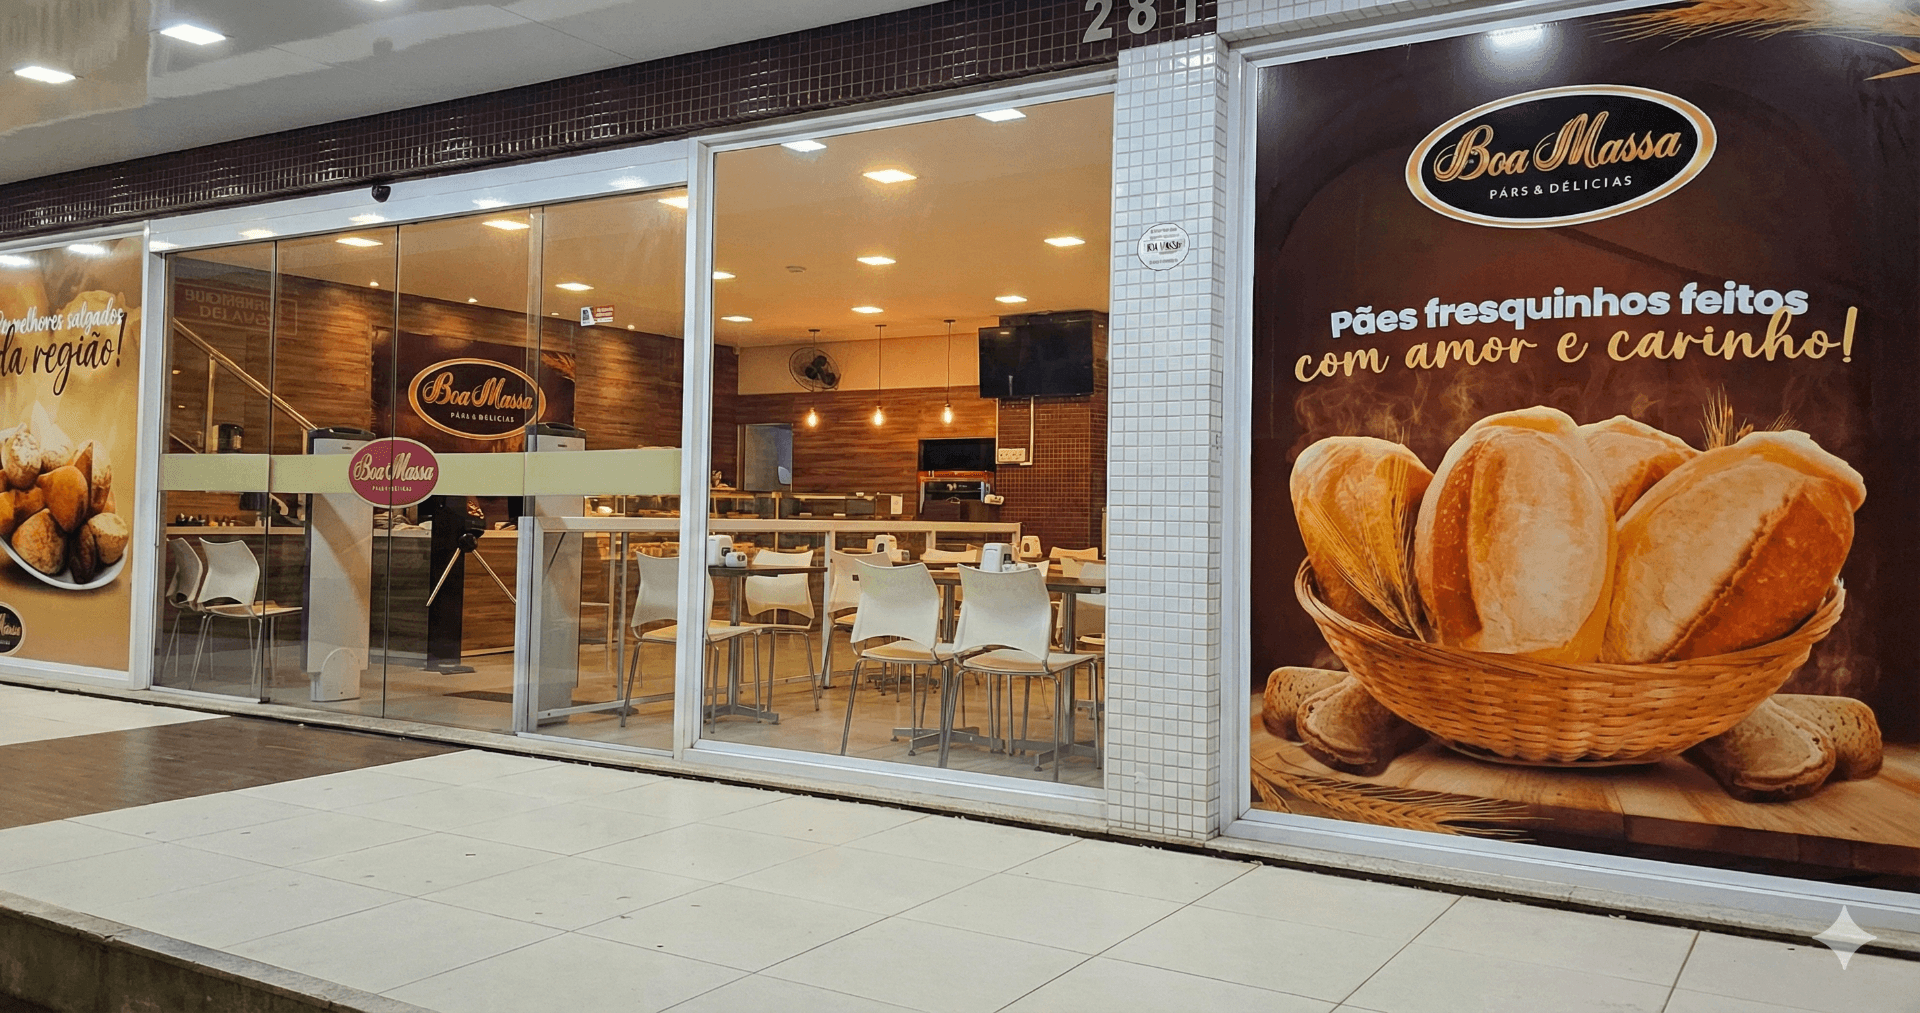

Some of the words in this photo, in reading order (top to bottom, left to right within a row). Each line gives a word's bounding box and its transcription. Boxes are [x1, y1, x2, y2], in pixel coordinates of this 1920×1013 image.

[1433, 124, 1530, 182] Boa
[1533, 110, 1682, 172] Massa
[1489, 186, 1529, 200] PÁRS
[1533, 184, 1543, 195] &
[1549, 175, 1632, 194] DÉLICIAS
[67, 296, 124, 336] salgados
[1330, 305, 1418, 339] Pães
[1424, 286, 1671, 330] fresquinhos
[1679, 280, 1809, 315] feitos
[33, 312, 127, 396] região!
[1294, 348, 1390, 383] com
[1404, 336, 1538, 370] amor
[1556, 331, 1589, 363] e
[1607, 306, 1858, 363] carinho!
[422, 371, 471, 405] Boa
[471, 377, 533, 409] Massa
[353, 452, 385, 482] Boa
[385, 452, 434, 482] Massa
